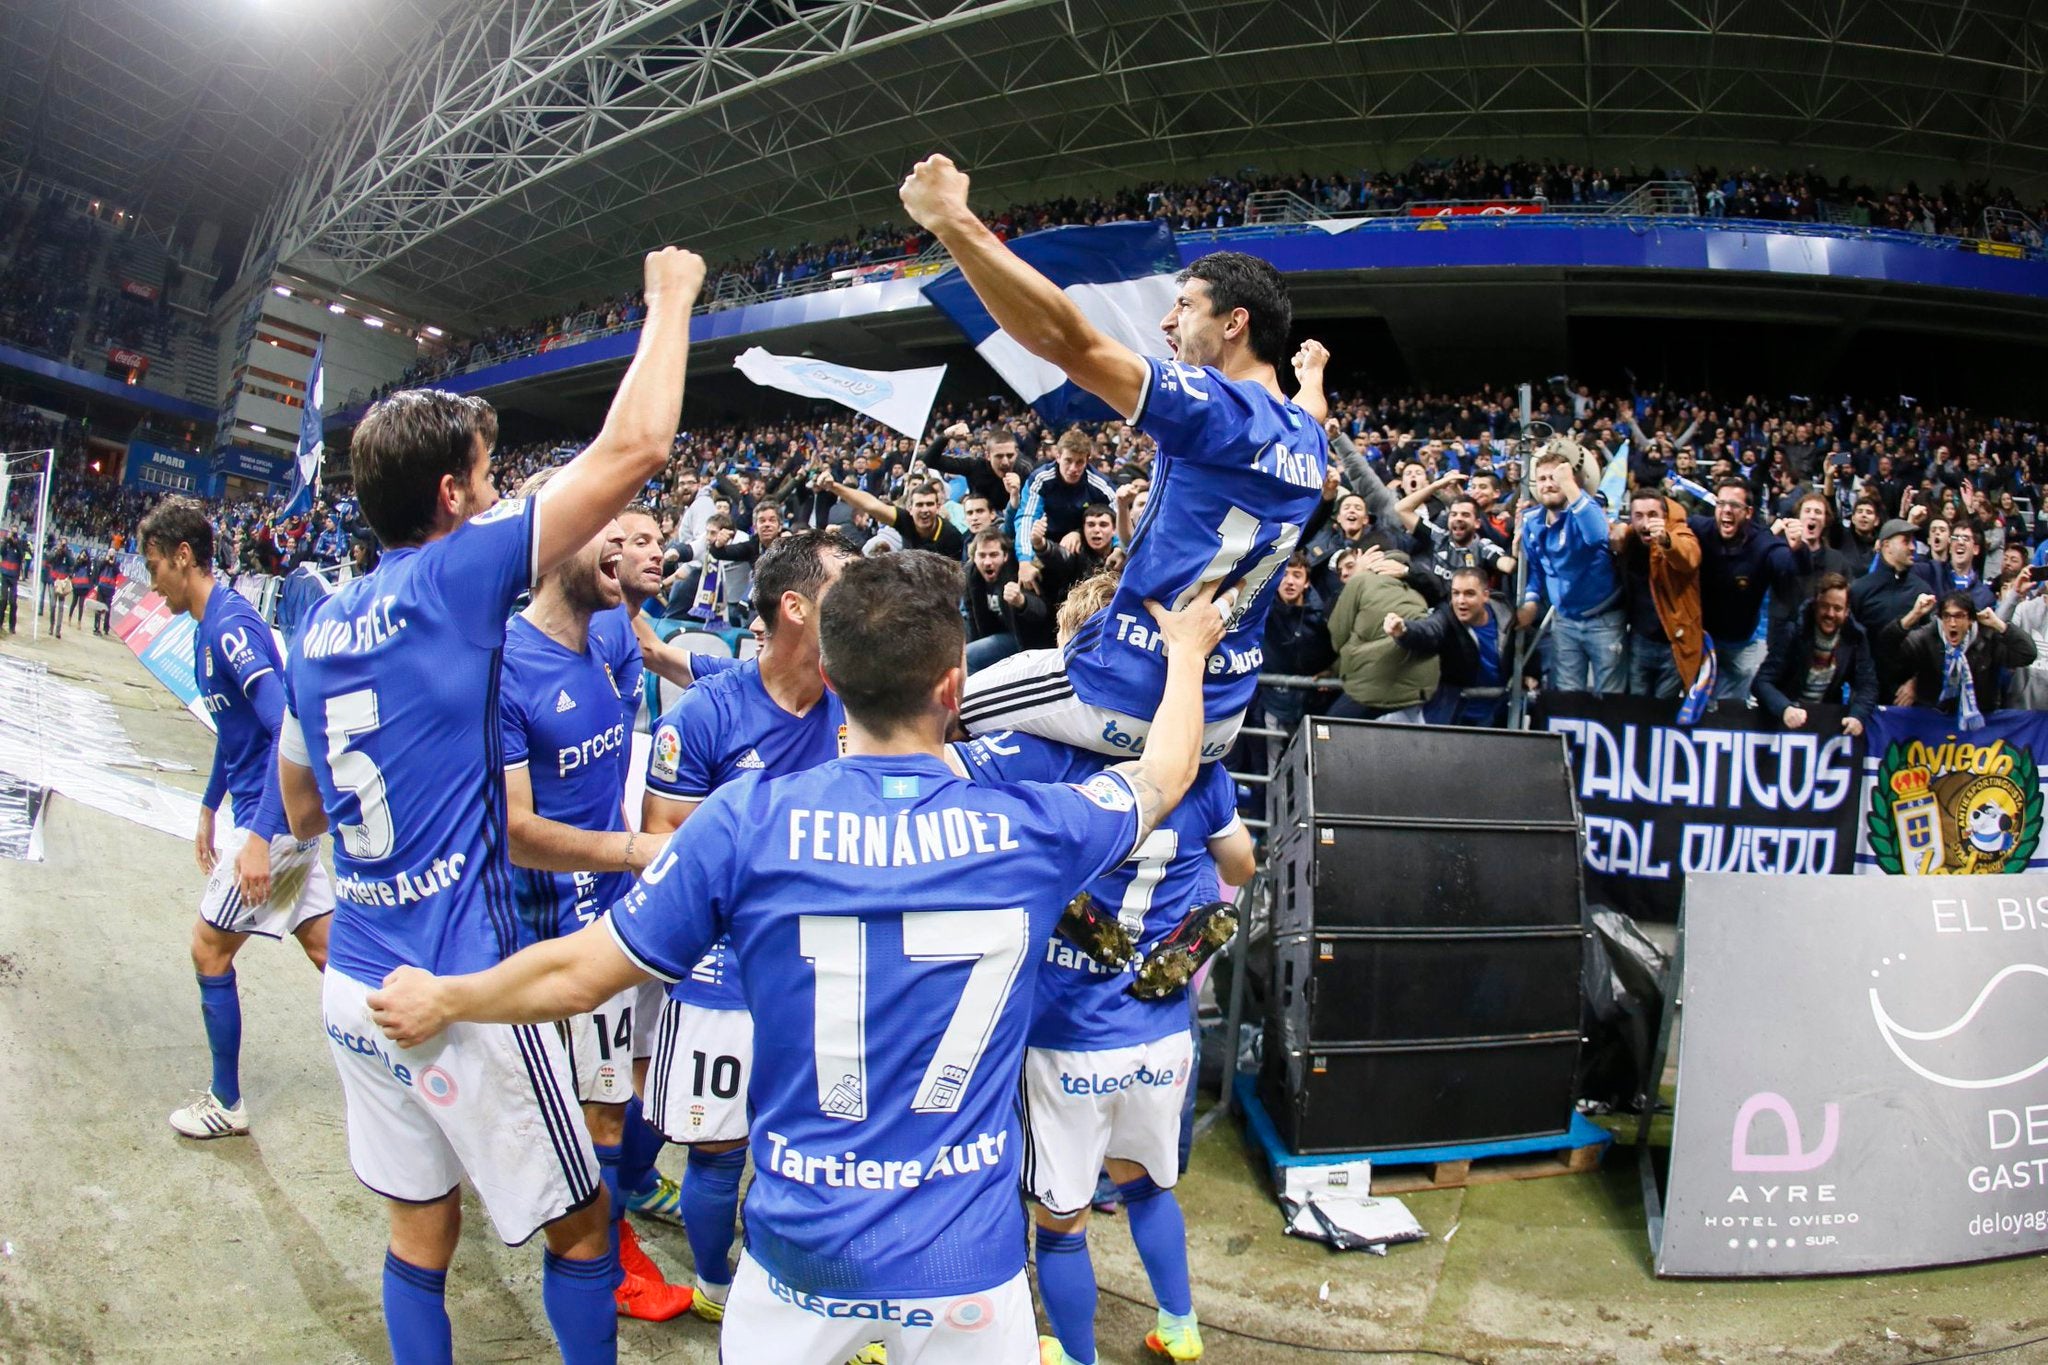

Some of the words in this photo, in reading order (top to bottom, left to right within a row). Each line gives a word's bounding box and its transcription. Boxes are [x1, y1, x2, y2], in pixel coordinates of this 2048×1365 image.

[324, 688, 395, 861] 5
[1907, 734, 2014, 777] Oviedo
[789, 806, 1019, 867] FERNÁNDEZ
[1583, 815, 1671, 879] EAL
[1932, 899, 1988, 933] EL
[593, 1006, 632, 1060] 14
[799, 907, 1029, 1121] 17
[693, 1050, 742, 1099] 10
[767, 1131, 922, 1190] Tartiere
[1727, 1185, 1837, 1203] AYRE
[1705, 1216, 1777, 1227] HOTEL
[1789, 1213, 1859, 1227] OVIEDO
[1805, 1235, 1839, 1246] SUP.
[1968, 1210, 2048, 1236] deloyag
